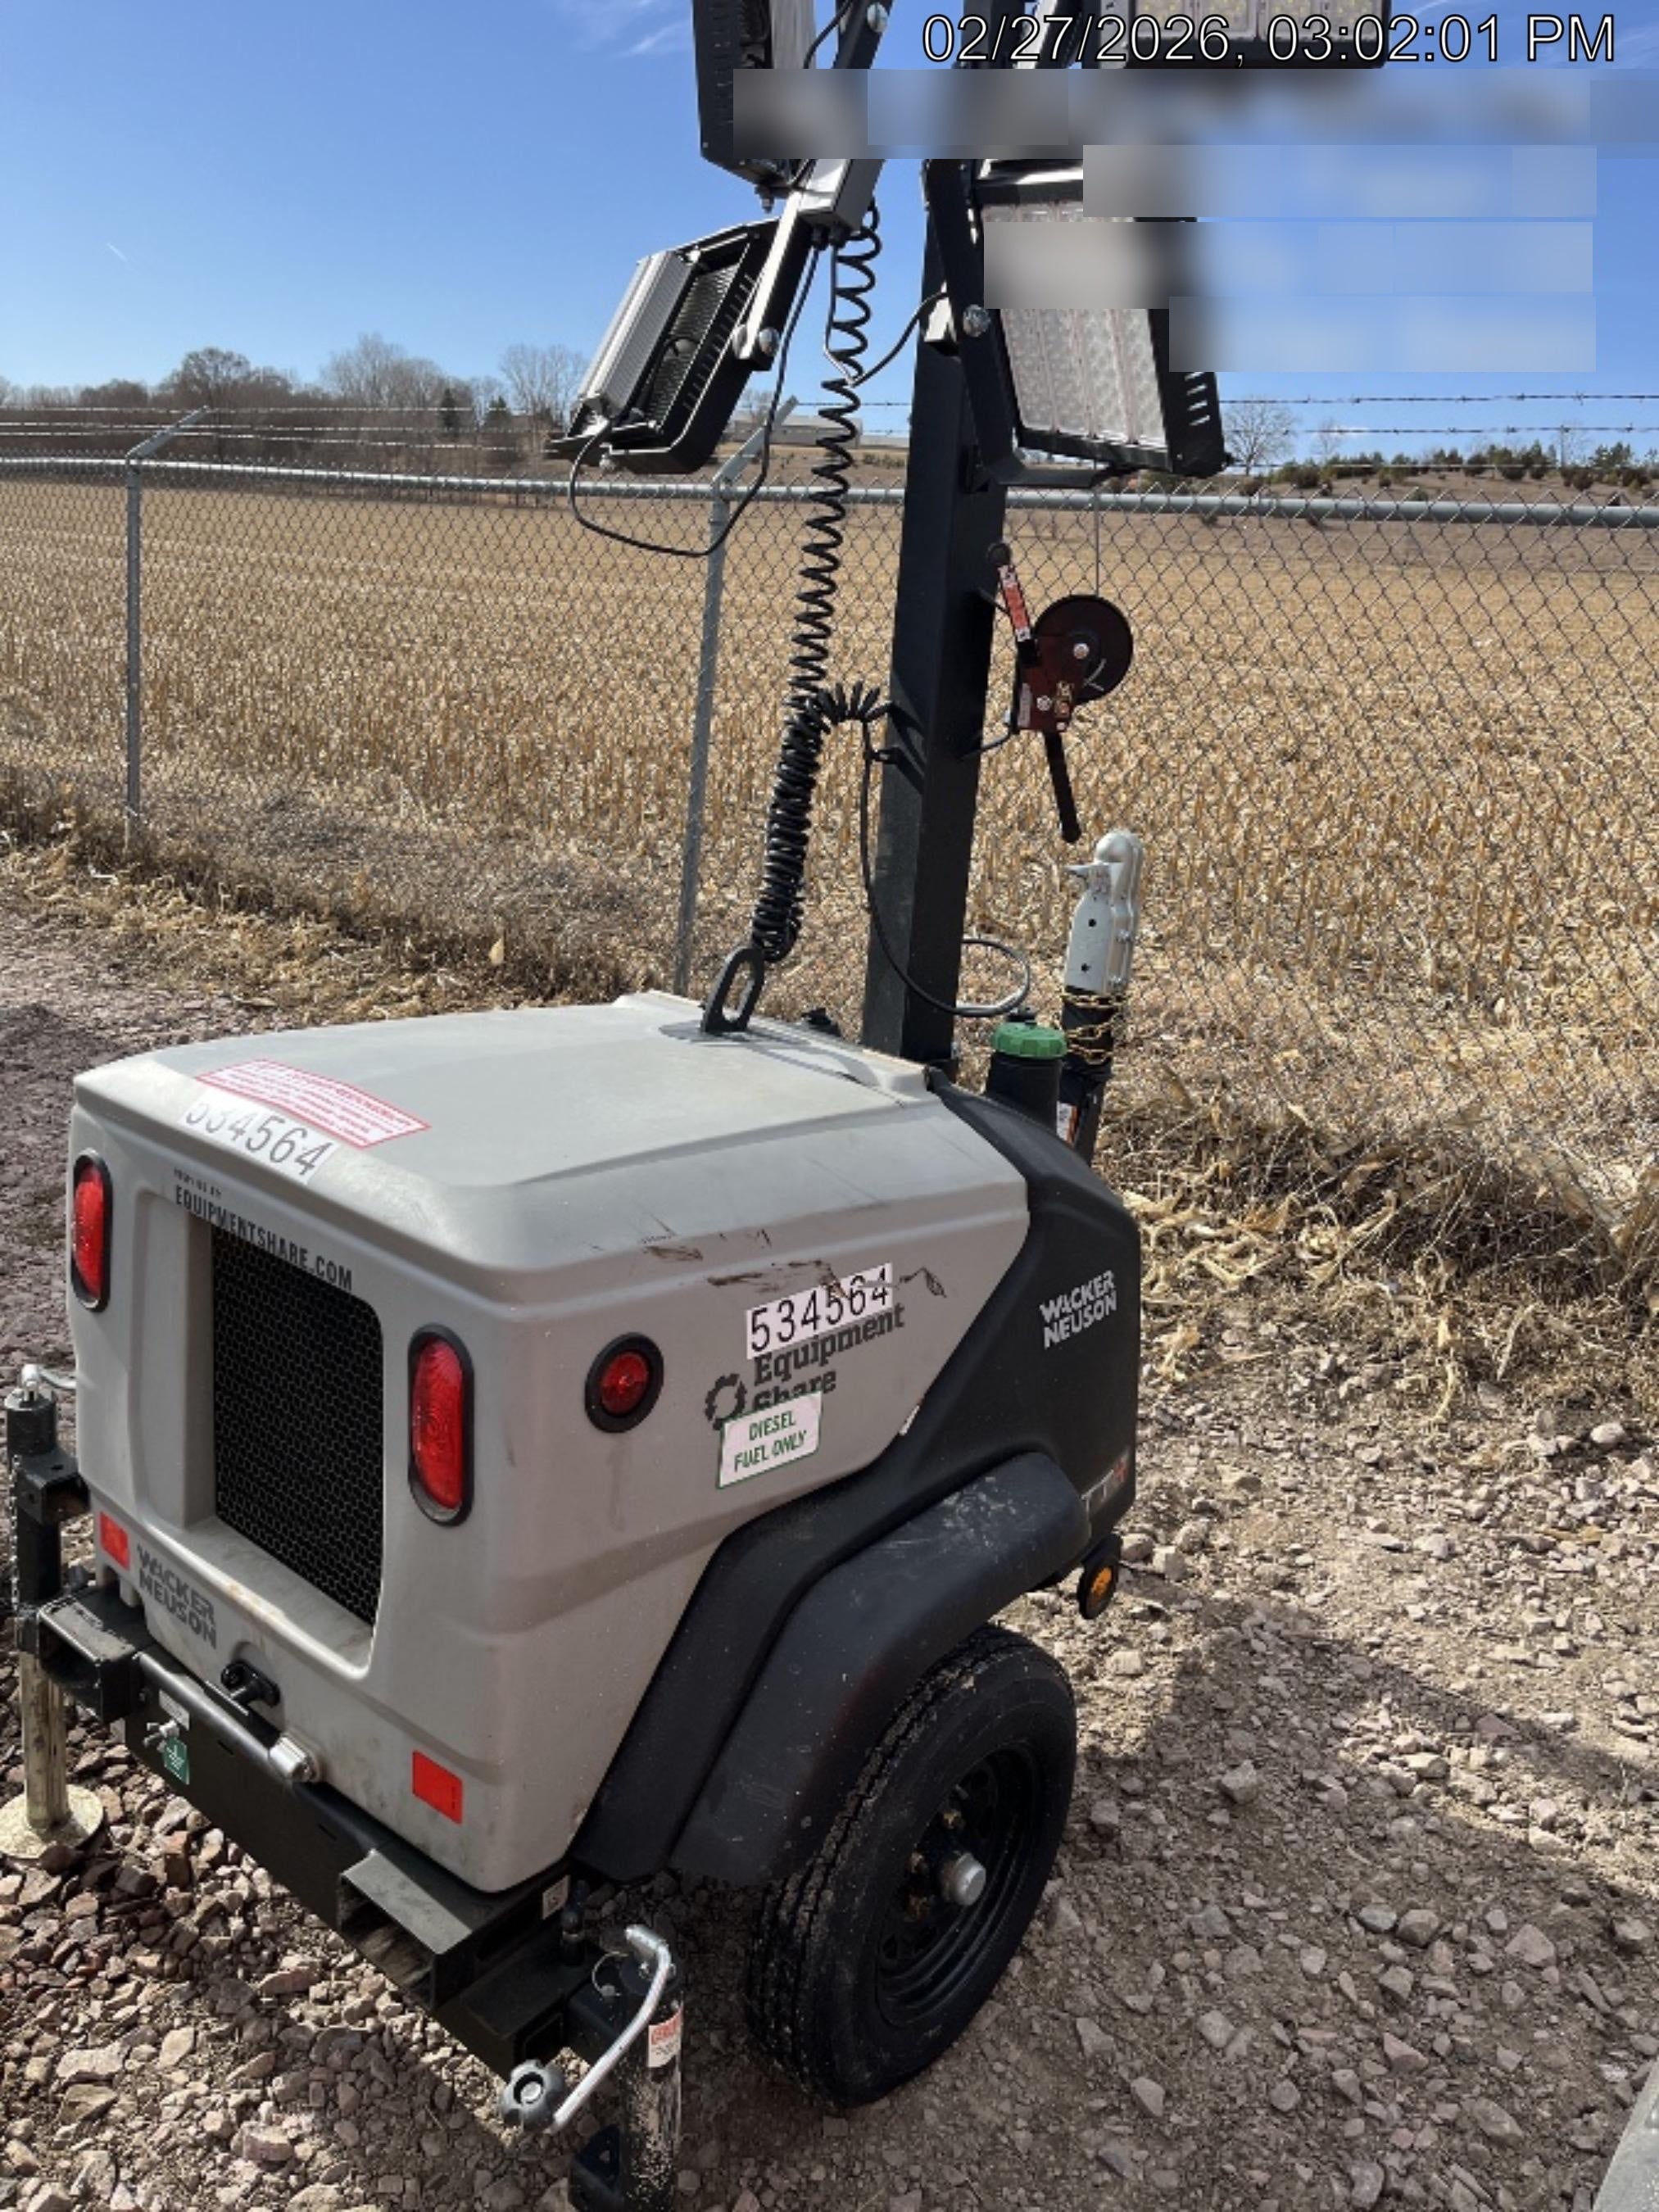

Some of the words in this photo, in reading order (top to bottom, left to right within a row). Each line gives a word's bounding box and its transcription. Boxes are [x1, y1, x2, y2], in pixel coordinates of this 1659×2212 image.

[175, 1185, 353, 1292] EQUIPMENTSHARE.COM
[750, 1267, 889, 1352] 534564
[1039, 1270, 1115, 1323] WACKER
[1044, 1290, 1117, 1349] NEUSON
[754, 1303, 905, 1386] Equipment
[749, 1410, 796, 1441] DIESEL
[754, 1370, 836, 1412] Share
[734, 1444, 768, 1472] FUEL
[772, 1430, 807, 1456] ONLY
[138, 1543, 215, 1623] WACKER
[139, 1566, 216, 1650] NEUSON
